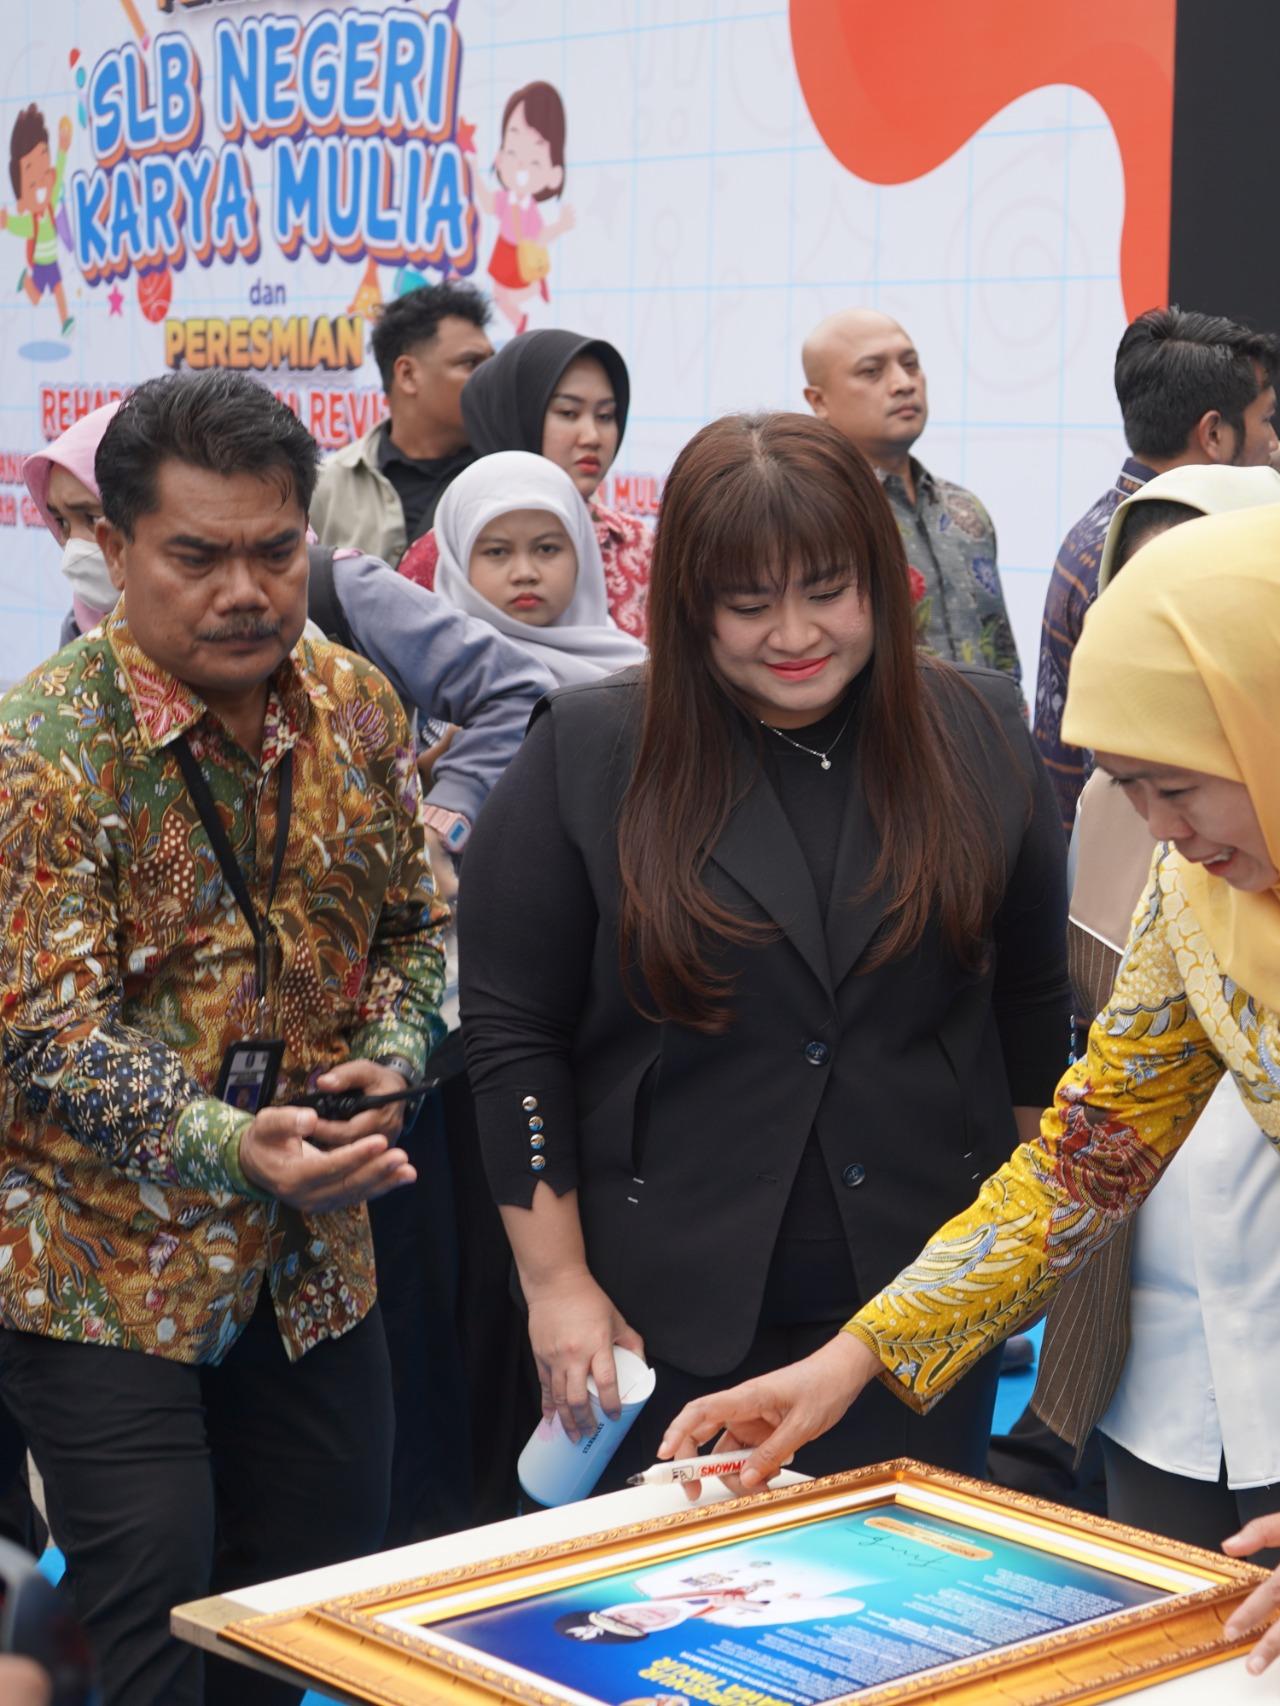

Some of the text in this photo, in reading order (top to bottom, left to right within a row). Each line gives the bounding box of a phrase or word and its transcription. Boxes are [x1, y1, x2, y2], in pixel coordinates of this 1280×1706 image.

[89, 12, 457, 161] SLB NEGERI
[73, 138, 471, 268] KARYA MULIA
[249, 278, 286, 305] dan
[165, 314, 364, 370] PERESMIAN
[310, 390, 391, 439] REVI
[700, 1460, 748, 1477] SNOWM
